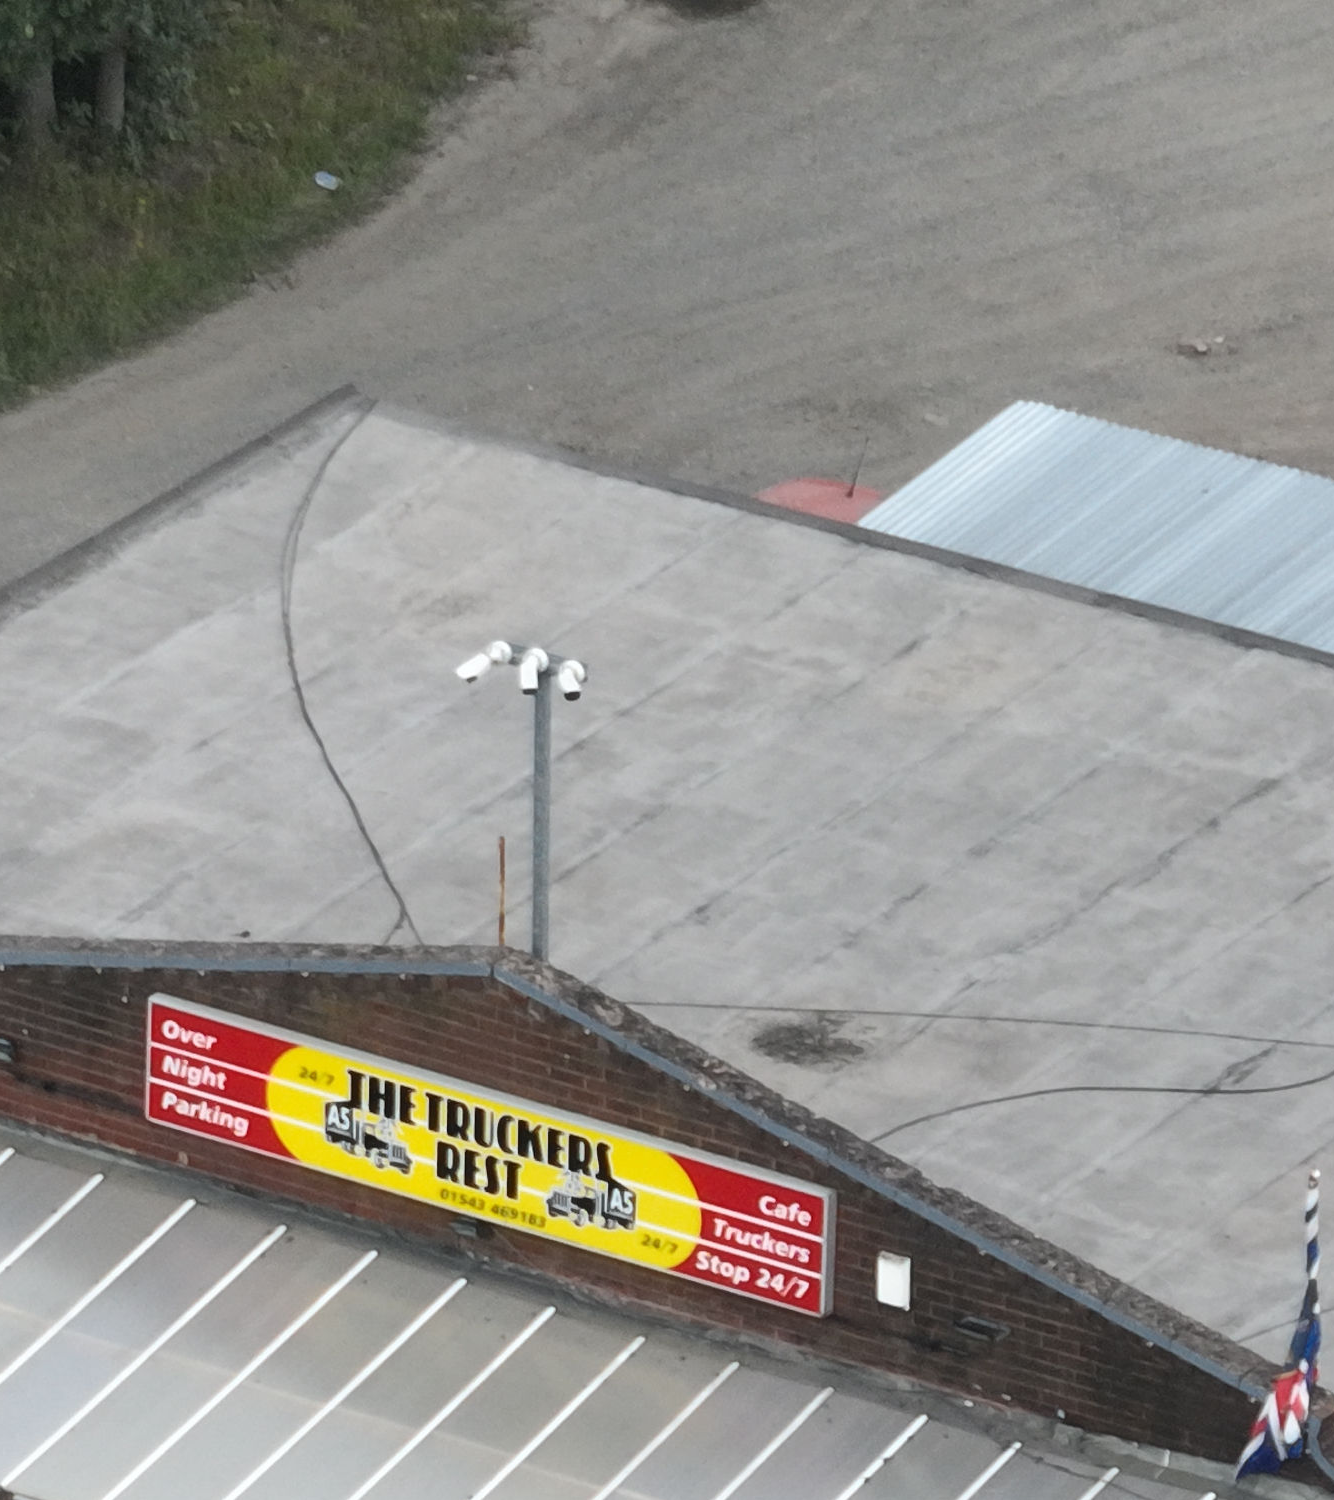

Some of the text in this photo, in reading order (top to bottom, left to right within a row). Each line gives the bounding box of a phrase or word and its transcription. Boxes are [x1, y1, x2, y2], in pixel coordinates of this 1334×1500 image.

[161, 1019, 217, 1050] Over
[161, 1055, 227, 1090] Night
[298, 1066, 335, 1086] 24/7
[161, 1091, 250, 1137] Parking
[347, 1068, 612, 1182] THE TRUCKERS
[436, 1140, 522, 1201] REST
[439, 1188, 486, 1212] 01543
[758, 1195, 812, 1227] Cafe
[641, 1233, 679, 1255] 24/7
[713, 1217, 810, 1264] Truckers
[694, 1250, 810, 1300] Stop 24/7
